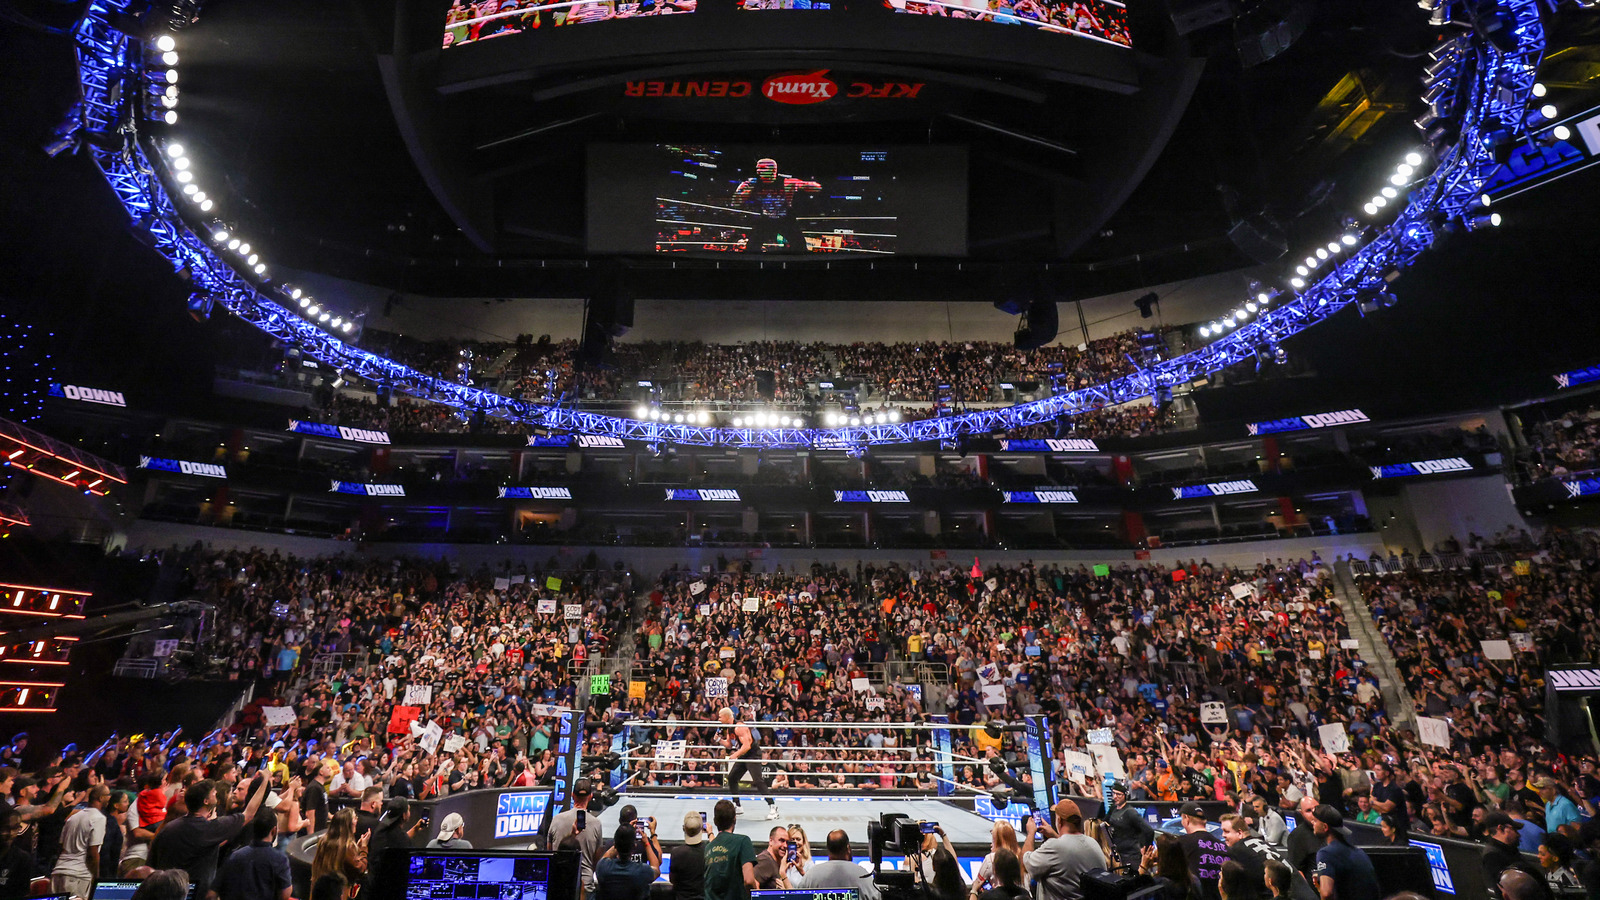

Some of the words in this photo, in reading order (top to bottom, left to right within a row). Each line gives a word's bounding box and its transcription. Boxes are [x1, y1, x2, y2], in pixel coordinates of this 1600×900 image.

[624, 81, 752, 97] CENTER
[767, 80, 832, 98] Yum!
[847, 83, 925, 98] KFC
[63, 385, 127, 407] DOWN
[1301, 409, 1371, 428] DOWN
[338, 426, 391, 444] DOWN
[1045, 439, 1100, 452] DOWN
[179, 461, 227, 478] DOWN
[1411, 457, 1473, 475] DOWN
[365, 484, 406, 496] DOWN
[530, 487, 572, 499] DOWN
[698, 489, 741, 501] DOWN
[1207, 479, 1259, 496] DOWN
[866, 490, 910, 503] DOWN
[1034, 491, 1079, 503] DOWN
[591, 685, 608, 693] ERA
[495, 813, 544, 838] DOW
[1198, 839, 1227, 852] SENT
